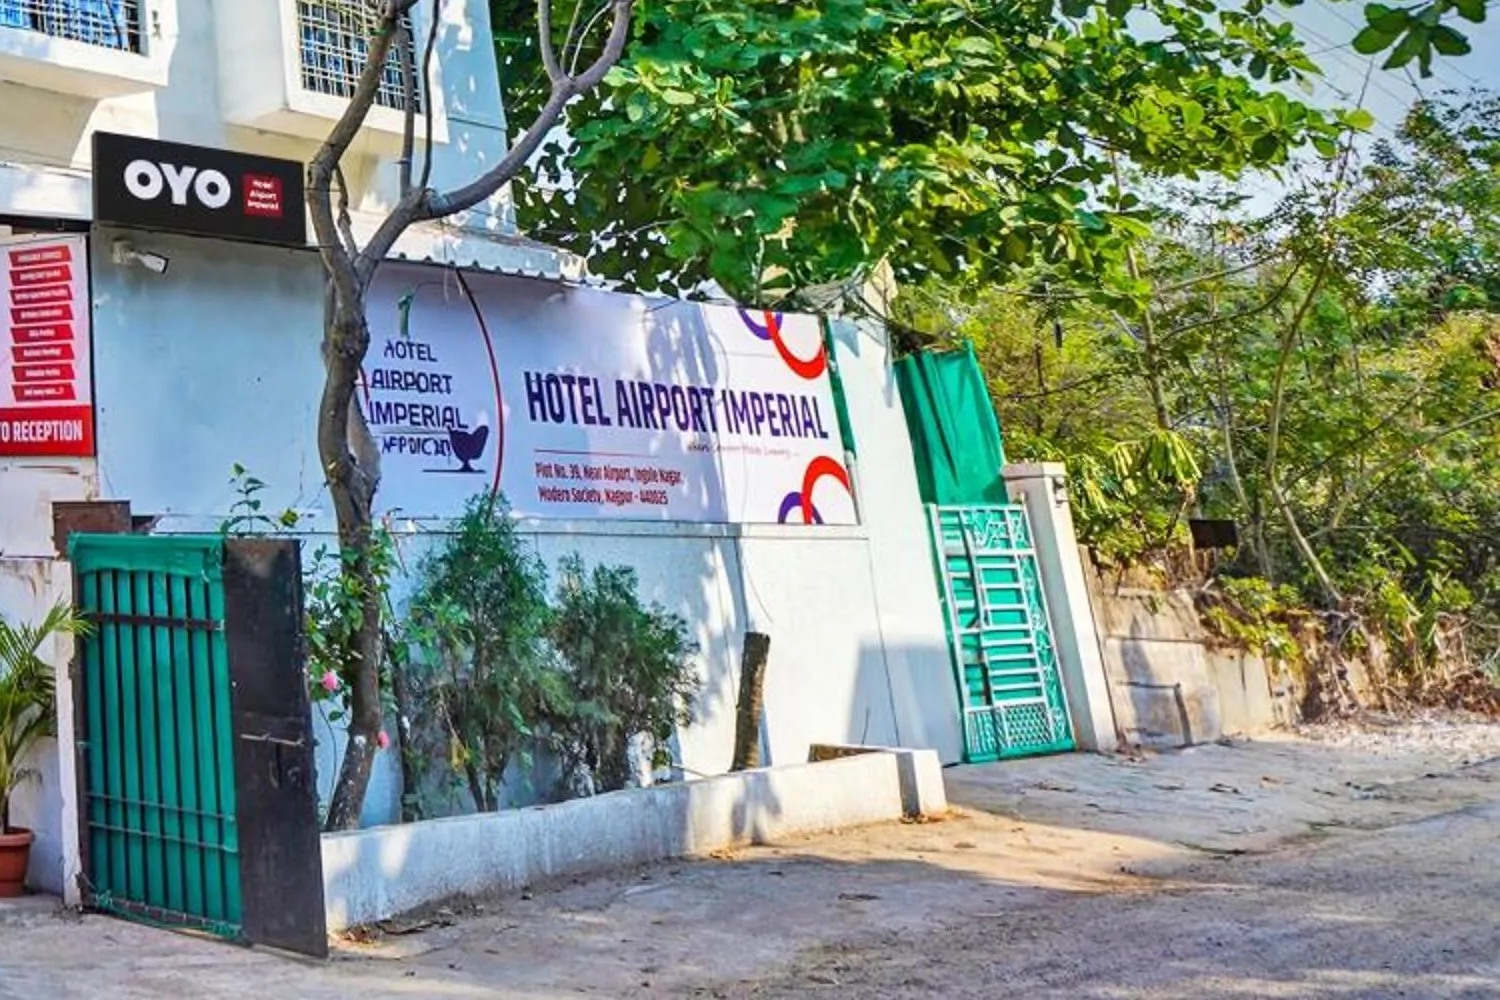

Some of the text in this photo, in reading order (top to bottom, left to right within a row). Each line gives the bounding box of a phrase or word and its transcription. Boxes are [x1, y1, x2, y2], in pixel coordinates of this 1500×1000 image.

[123, 159, 231, 209] OYO
[370, 368, 452, 395] AIRPORT
[368, 400, 469, 430] IMPERIAL
[524, 371, 829, 440] HOTEL AIRPORT IMPERIAL
[13, 419, 83, 442] RECEPTION
[535, 462, 553, 479] Plot
[537, 486, 570, 503] Modern
[604, 488, 633, 507] Nagpur
